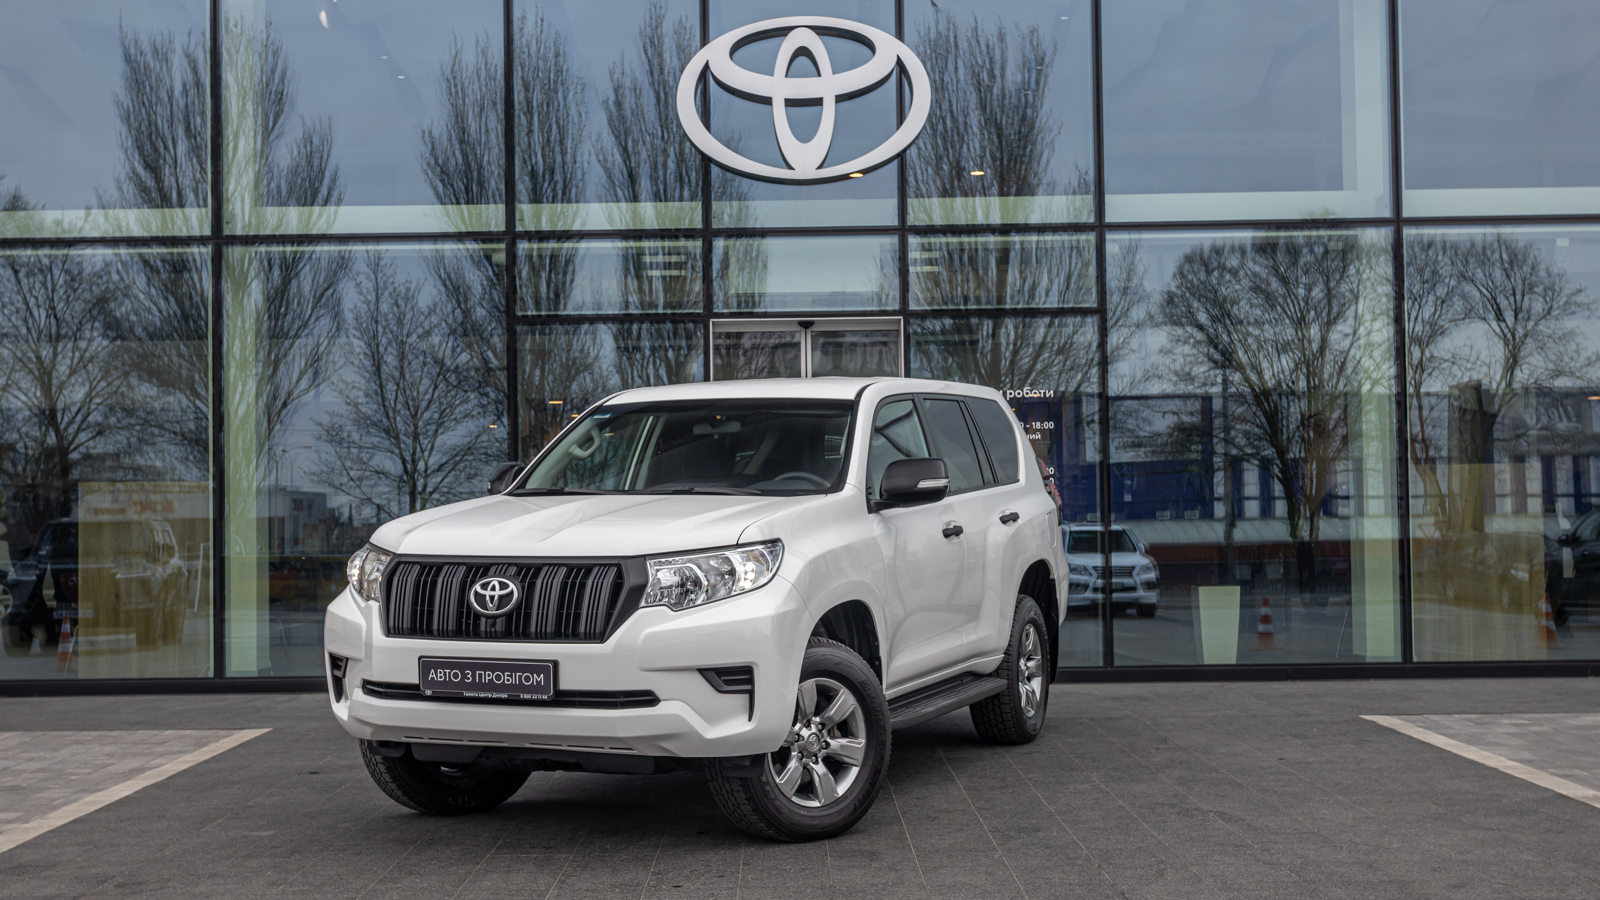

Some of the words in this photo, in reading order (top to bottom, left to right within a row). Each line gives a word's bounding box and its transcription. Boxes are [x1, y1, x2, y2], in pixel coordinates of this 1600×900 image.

[1006, 387, 1054, 400] роботи
[1031, 421, 1054, 429] 18:00
[428, 668, 461, 682] АВТО
[464, 670, 472, 683] З
[476, 671, 544, 686] ПРОБІГОМ
